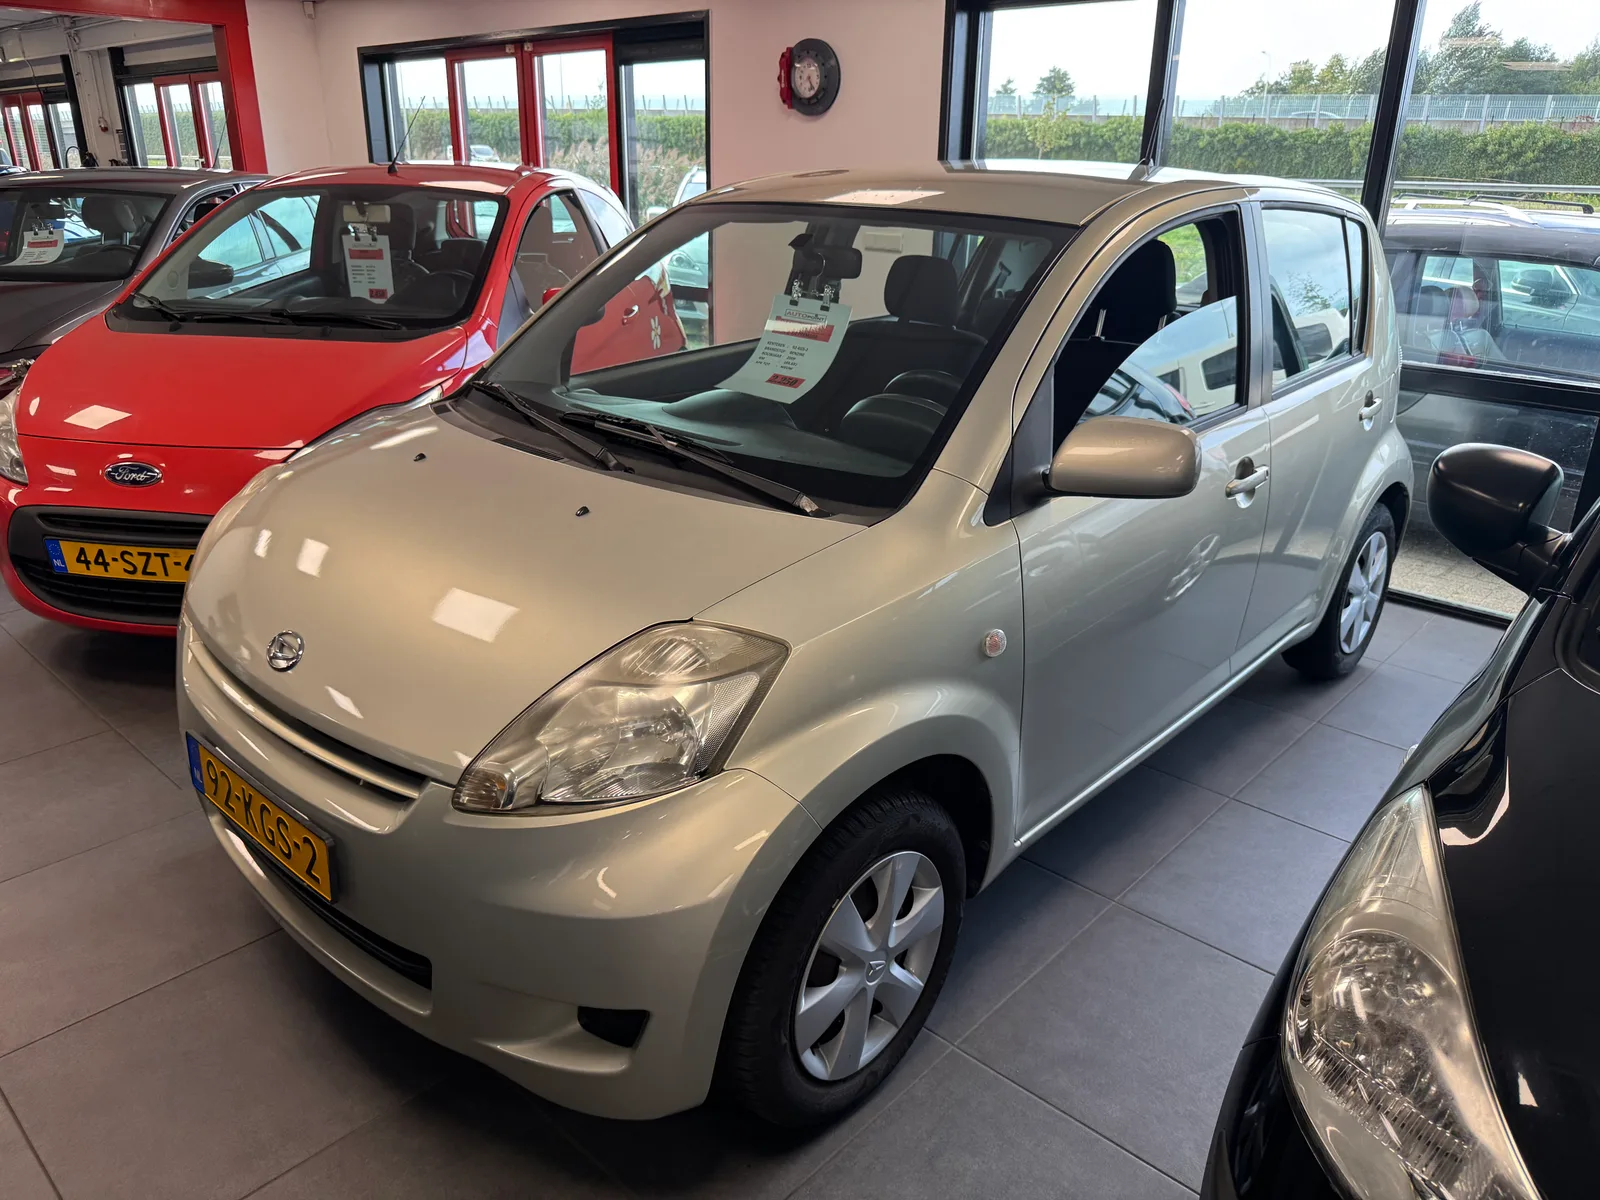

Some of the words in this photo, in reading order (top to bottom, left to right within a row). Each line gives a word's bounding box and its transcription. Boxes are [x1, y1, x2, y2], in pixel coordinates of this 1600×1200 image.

[111, 465, 152, 482] Ford
[53, 559, 65, 568] NL
[206, 758, 321, 885] 92-KGS-2
